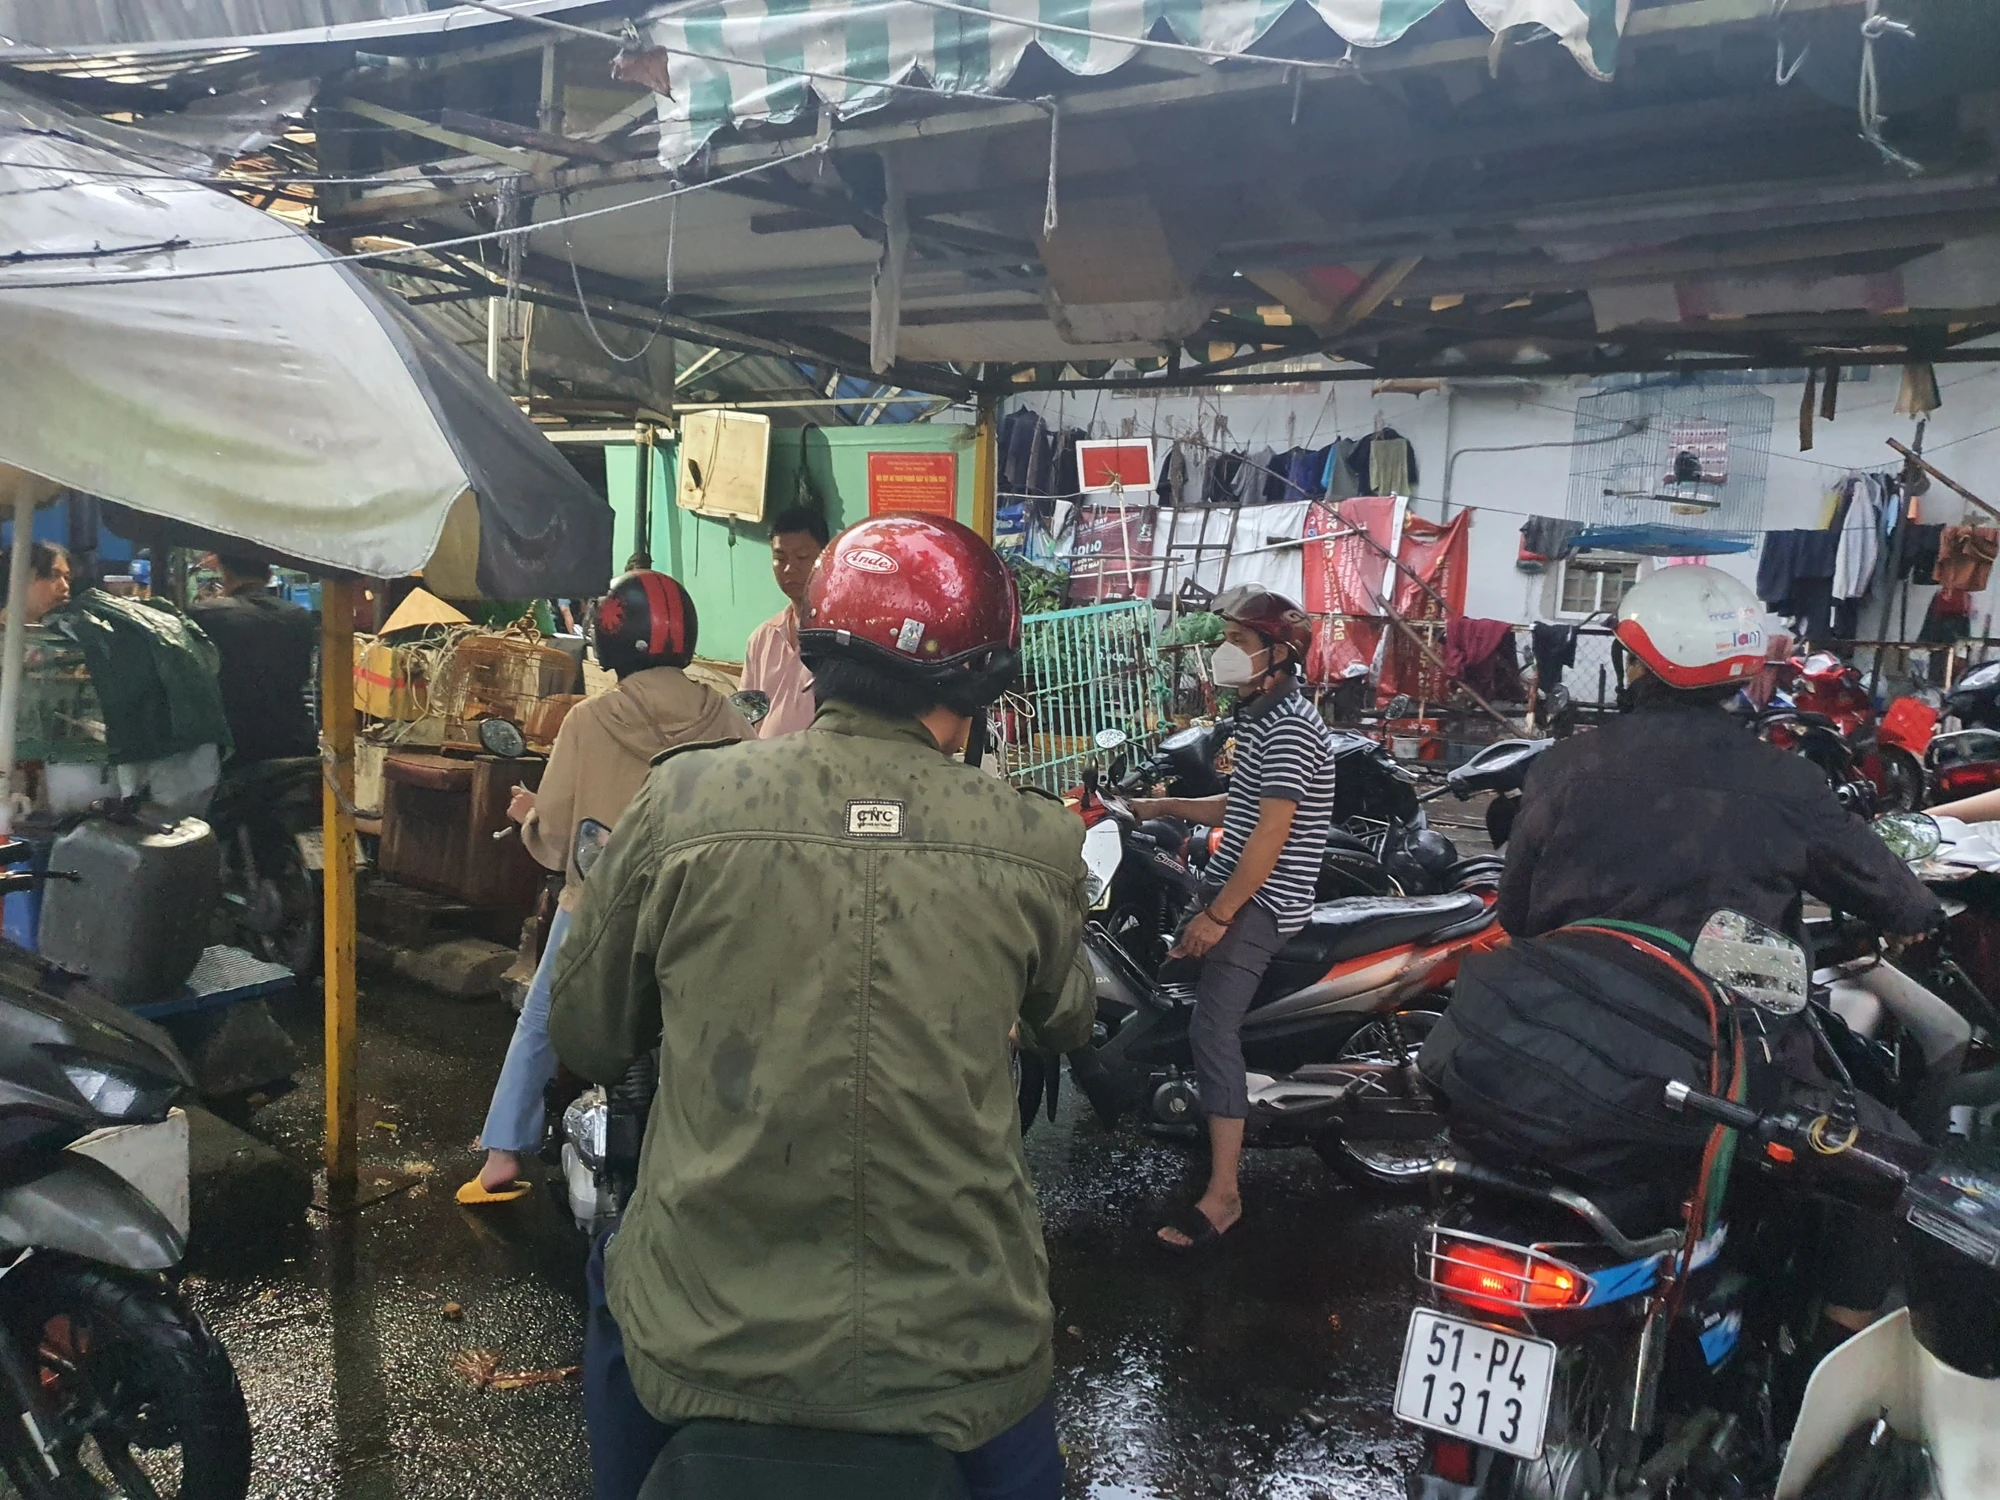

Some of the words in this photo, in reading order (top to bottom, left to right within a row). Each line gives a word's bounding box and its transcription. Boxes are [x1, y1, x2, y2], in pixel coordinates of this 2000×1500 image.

[1334, 620, 1345, 640] BIA
[1427, 1321, 1526, 1391] 51-P4
[1422, 1374, 1522, 1444] 1313
